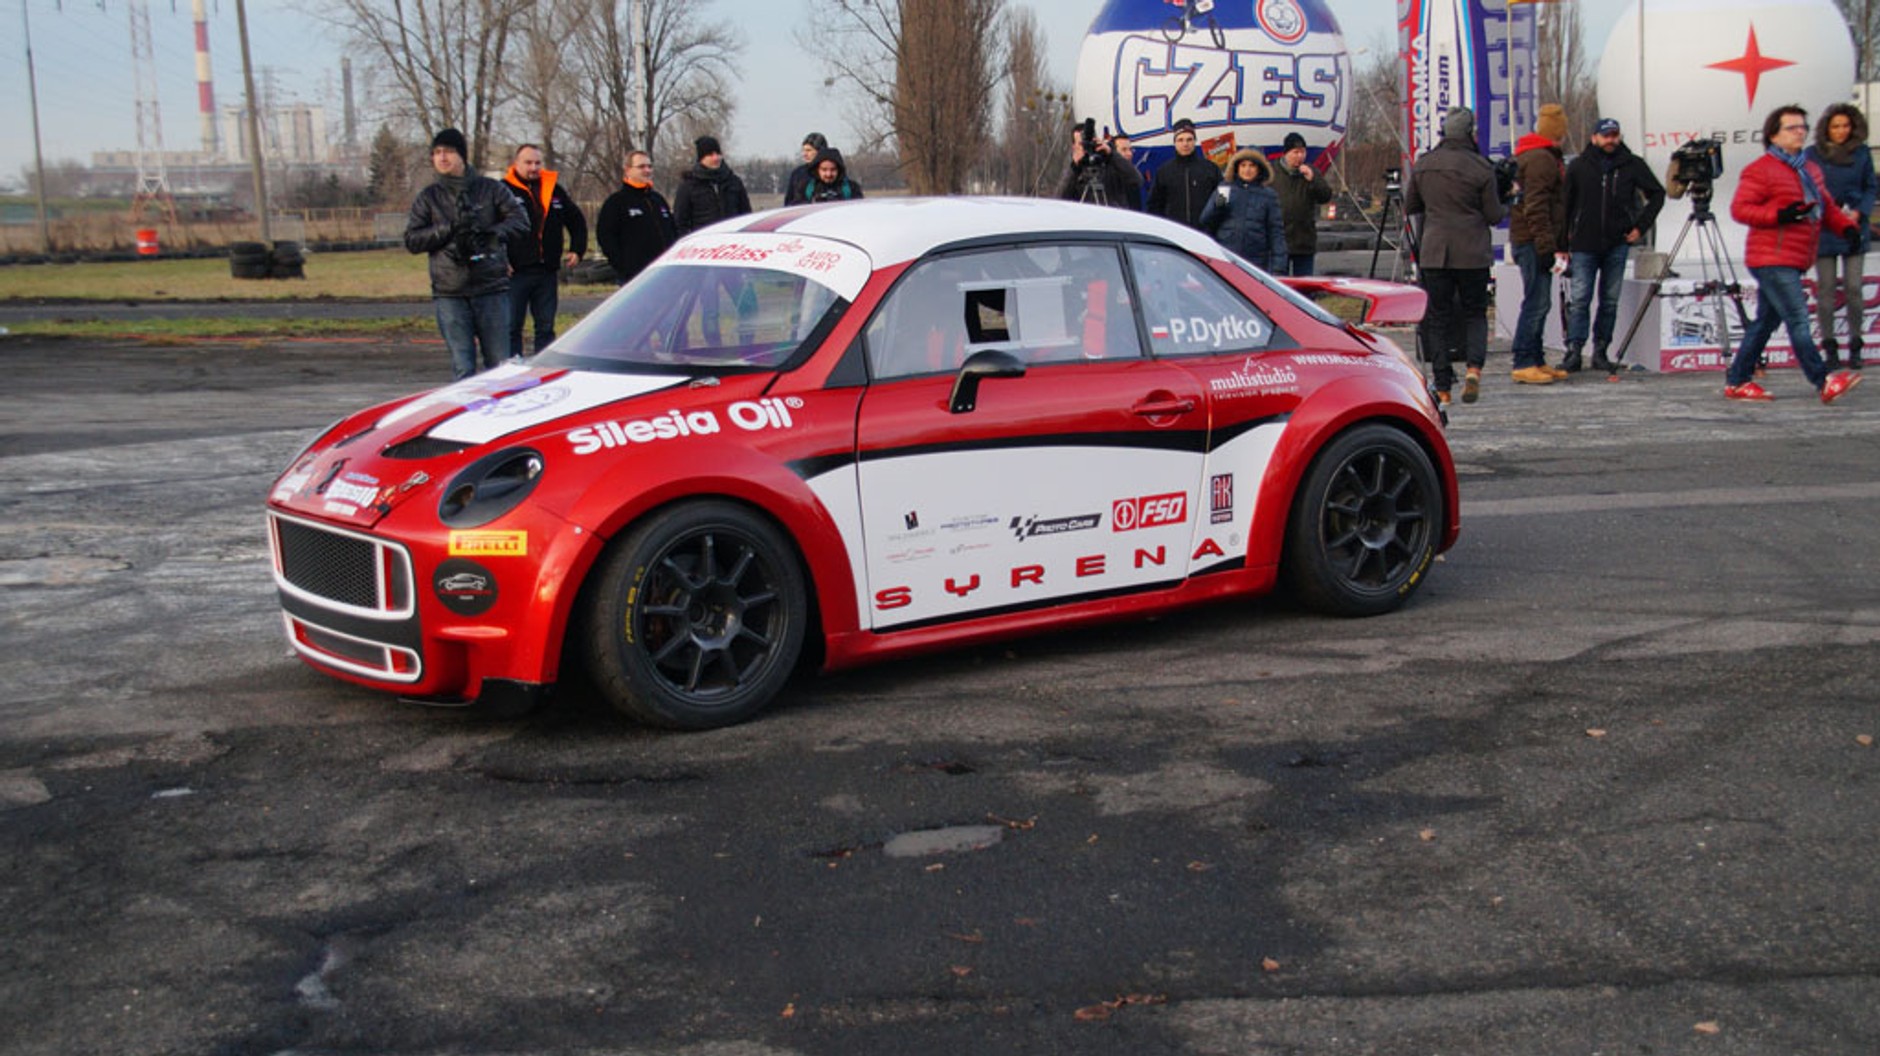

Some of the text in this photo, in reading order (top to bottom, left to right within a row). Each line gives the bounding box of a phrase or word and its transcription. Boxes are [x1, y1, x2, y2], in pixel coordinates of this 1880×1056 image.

[1644, 131, 1699, 148] CITY
[670, 244, 772, 262] NordGlass
[805, 250, 841, 264] AUTO
[1169, 316, 1261, 347] P.Dytko
[567, 409, 720, 455] Silesia
[1140, 496, 1185, 524] FSO
[455, 534, 519, 551] PIRELLI
